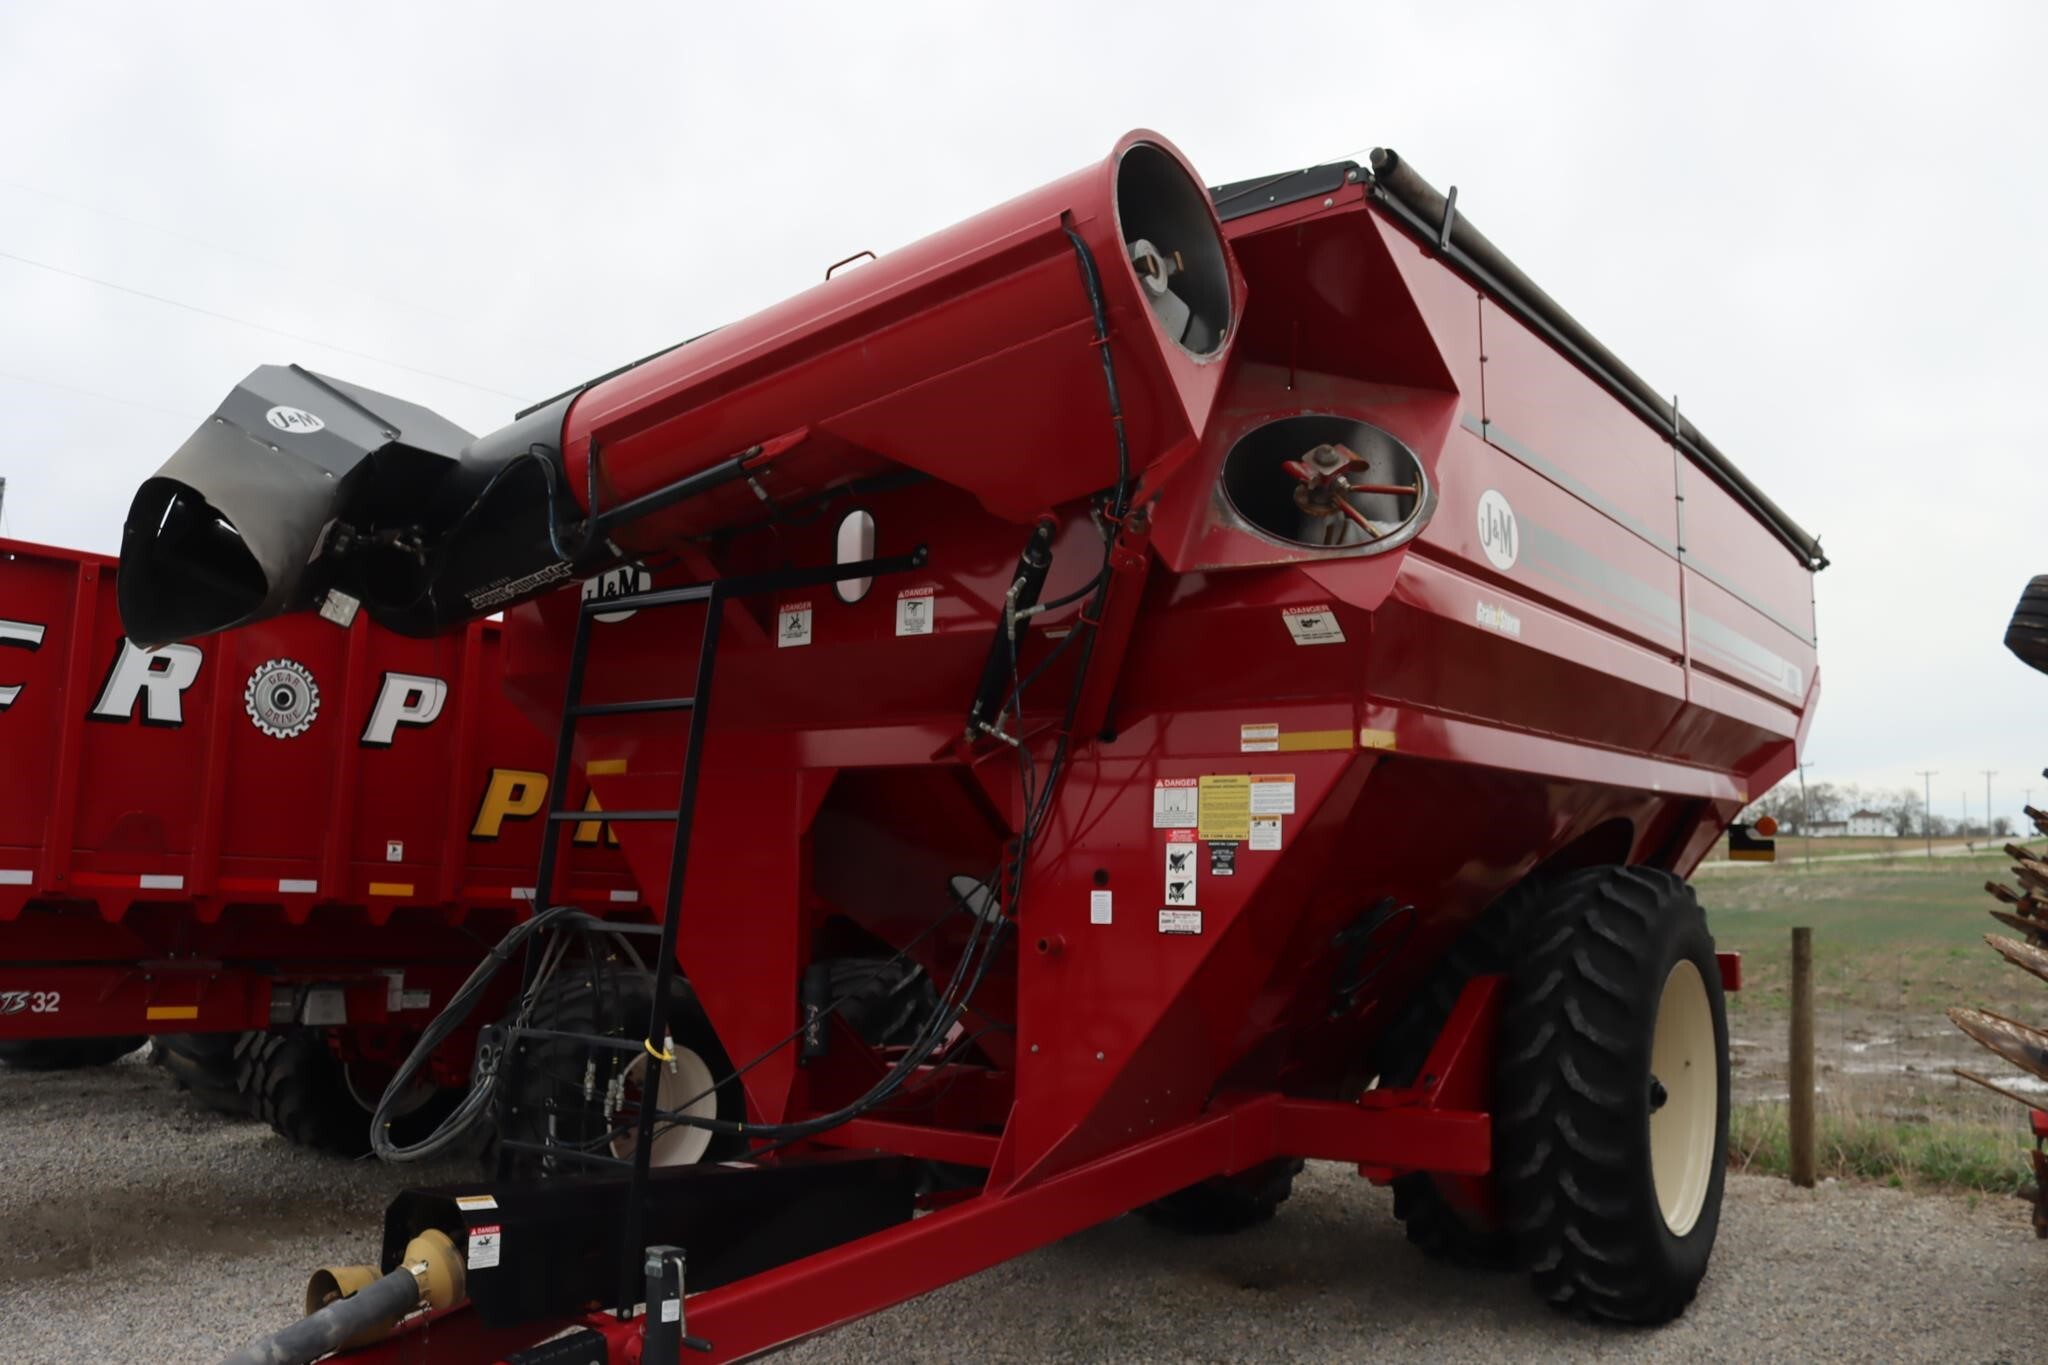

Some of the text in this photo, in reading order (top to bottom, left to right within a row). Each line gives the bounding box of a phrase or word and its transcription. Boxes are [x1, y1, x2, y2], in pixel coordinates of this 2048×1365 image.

[271, 411, 320, 429] J&M
[1480, 501, 1513, 559] J&M
[904, 587, 934, 598] DANGER
[785, 601, 812, 612] DANGER
[1289, 604, 1329, 614] DANGER
[268, 671, 301, 687] GEAR
[265, 708, 301, 724] DRIVE
[1164, 778, 1197, 788] DANGER
